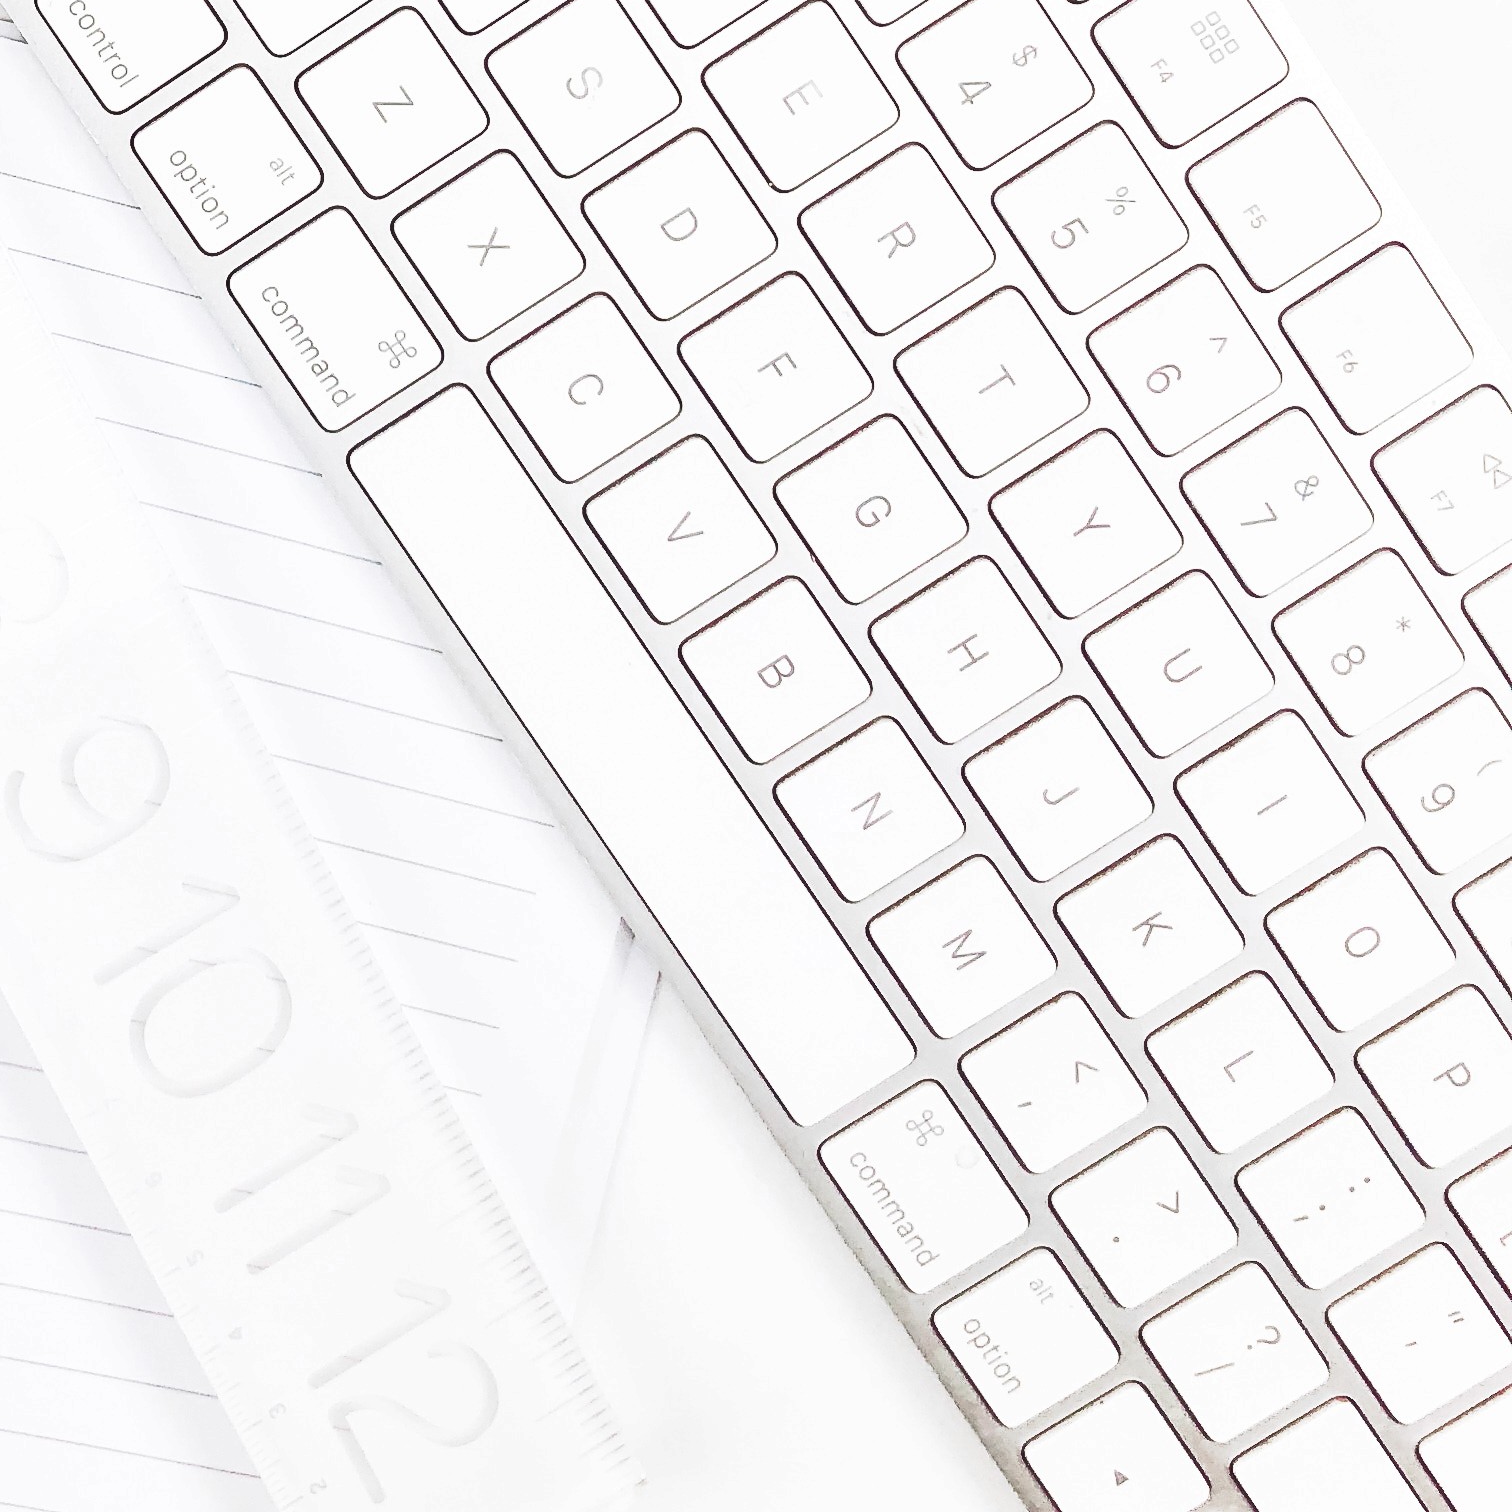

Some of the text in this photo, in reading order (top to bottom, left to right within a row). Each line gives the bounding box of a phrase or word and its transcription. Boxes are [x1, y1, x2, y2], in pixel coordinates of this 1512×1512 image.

[565, 66, 604, 100] S
[1150, 57, 1175, 84] F4
[371, 84, 415, 125] Z
[781, 79, 824, 116] E
[957, 80, 993, 106] 4
[269, 157, 296, 187] alt
[169, 148, 230, 231] option
[658, 206, 699, 243] D
[1050, 216, 1090, 250] 5
[1242, 203, 1268, 230] F5
[466, 226, 512, 268] X
[876, 220, 917, 260] R
[260, 285, 357, 409] command
[1335, 348, 1360, 374] F6
[756, 351, 799, 378] F
[977, 363, 1017, 395] T
[1145, 363, 1182, 395] 6
[567, 373, 605, 406] C
[854, 495, 893, 529] G
[1239, 501, 1279, 527] 7
[1429, 489, 1456, 512] F7
[666, 510, 705, 543] V
[1072, 504, 1112, 538] Y
[946, 632, 990, 673] H
[1162, 647, 1204, 684] U
[1330, 644, 1367, 677] 8
[756, 653, 796, 690] B
[3, 714, 172, 864] 9
[1042, 786, 1081, 806] J
[1420, 782, 1456, 814] 9
[850, 791, 894, 831] N
[1131, 910, 1174, 949] K
[1344, 925, 1382, 959] O
[941, 928, 988, 972] M
[92, 875, 293, 1100] 10
[1223, 1049, 1256, 1084] L
[1432, 1061, 1472, 1088] P
[214, 1101, 392, 1276] 11
[848, 1151, 942, 1268] command
[1029, 1278, 1055, 1305] alt
[962, 1317, 1021, 1395] option
[307, 1276, 501, 1506] 12
